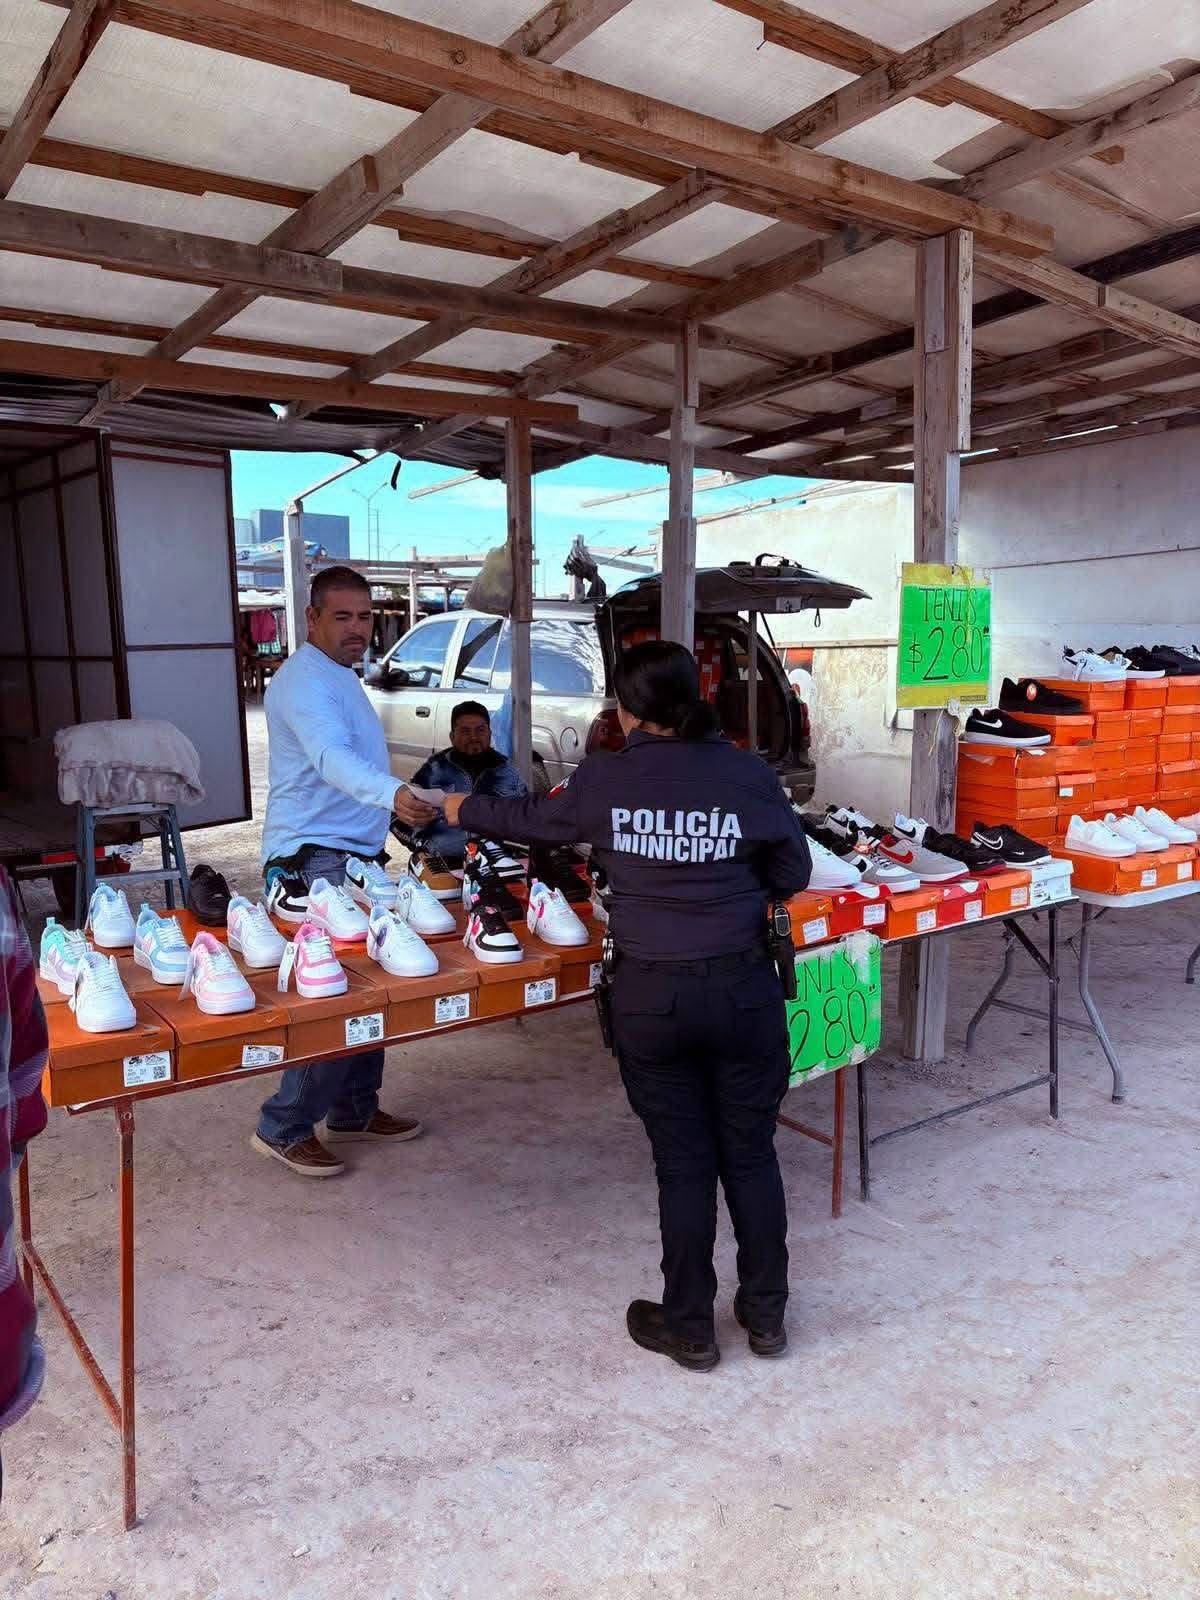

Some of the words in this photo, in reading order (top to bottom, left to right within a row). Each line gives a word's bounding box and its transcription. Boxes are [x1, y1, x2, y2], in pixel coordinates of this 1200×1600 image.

[918, 587, 977, 625] TENIS
[611, 807, 743, 839] POLICÍA
[791, 943, 858, 1003] NIS
